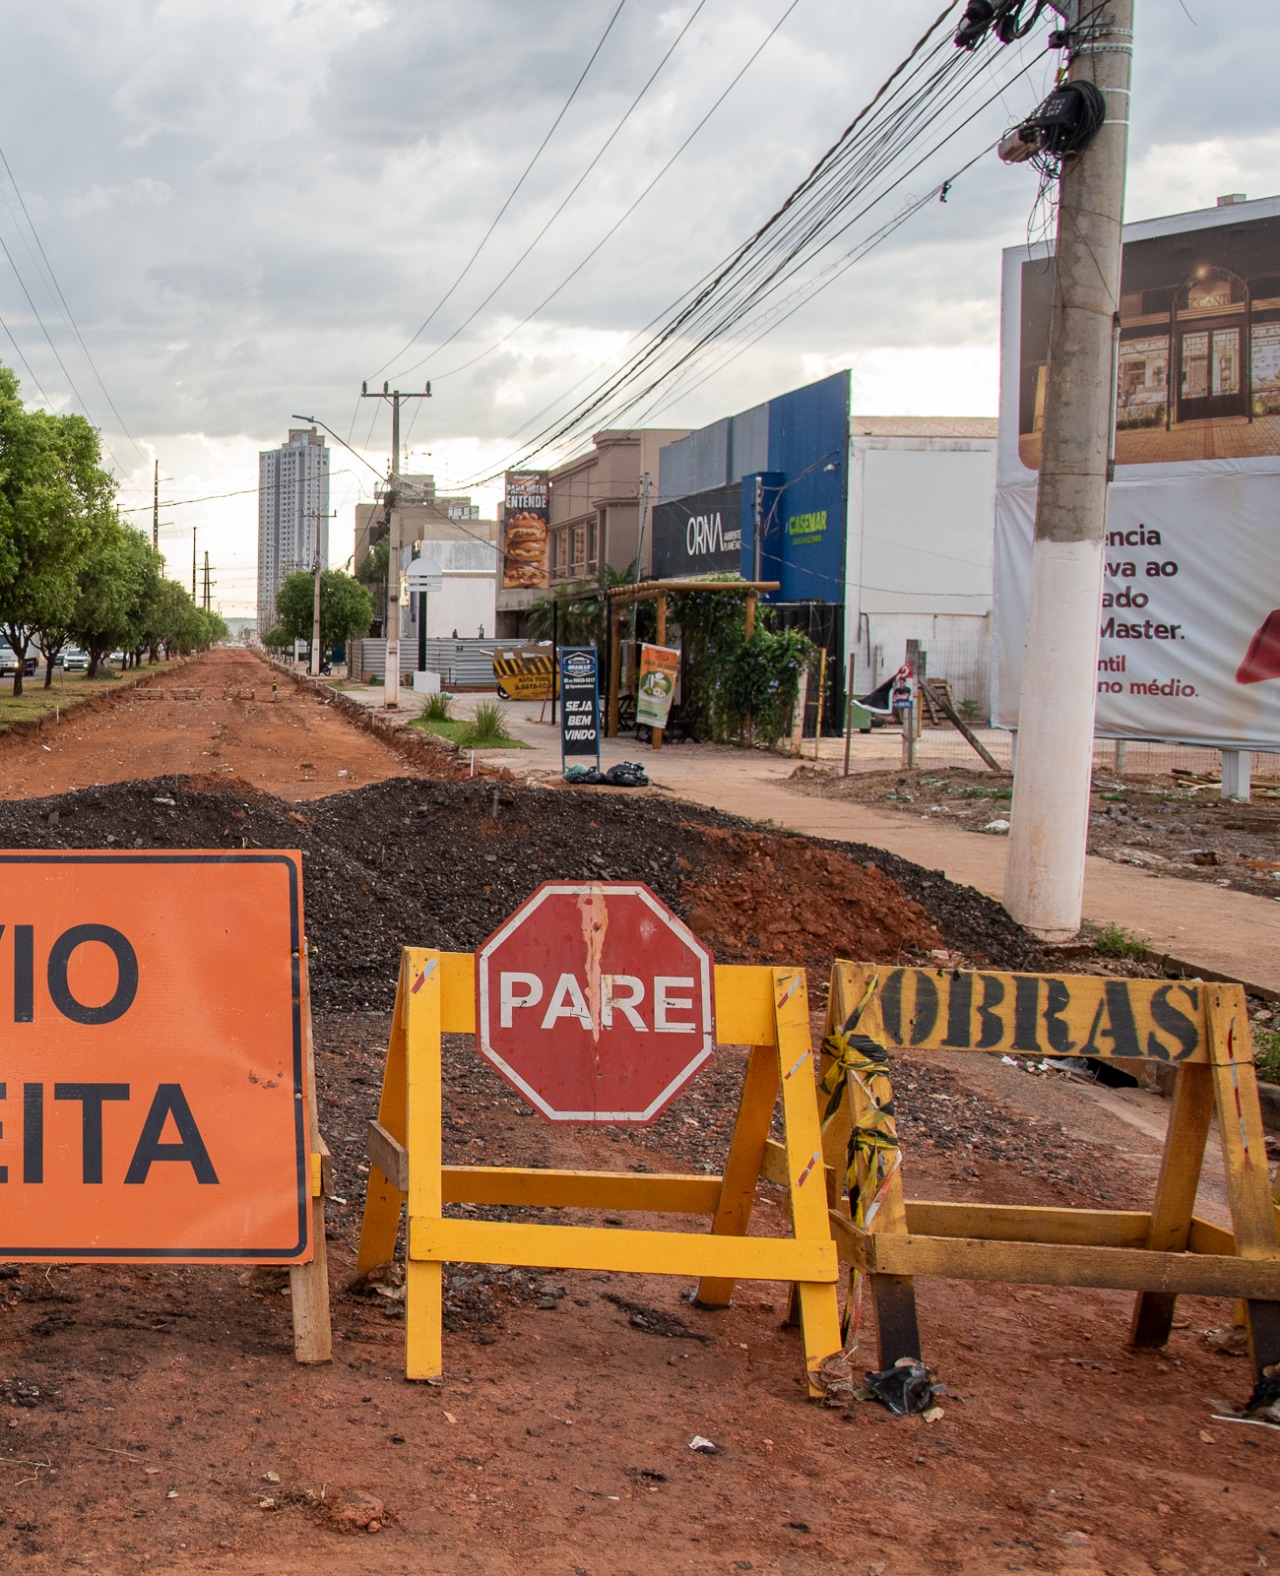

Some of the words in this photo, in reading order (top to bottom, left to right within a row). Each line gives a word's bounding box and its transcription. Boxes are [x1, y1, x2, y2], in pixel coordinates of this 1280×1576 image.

[505, 495, 547, 508] ENTENDE
[788, 510, 828, 535] CASEMAR
[686, 512, 725, 556] ORNA
[1105, 523, 1162, 546] ncia
[1145, 560, 1179, 578] ao
[1099, 617, 1186, 640] Master.
[1129, 678, 1199, 698] médio.
[565, 701, 593, 712] SEJA
[568, 715, 592, 726] BEM
[565, 729, 596, 740] VINDO
[499, 971, 696, 1034] PARE
[880, 968, 1200, 1061] OBRAS
